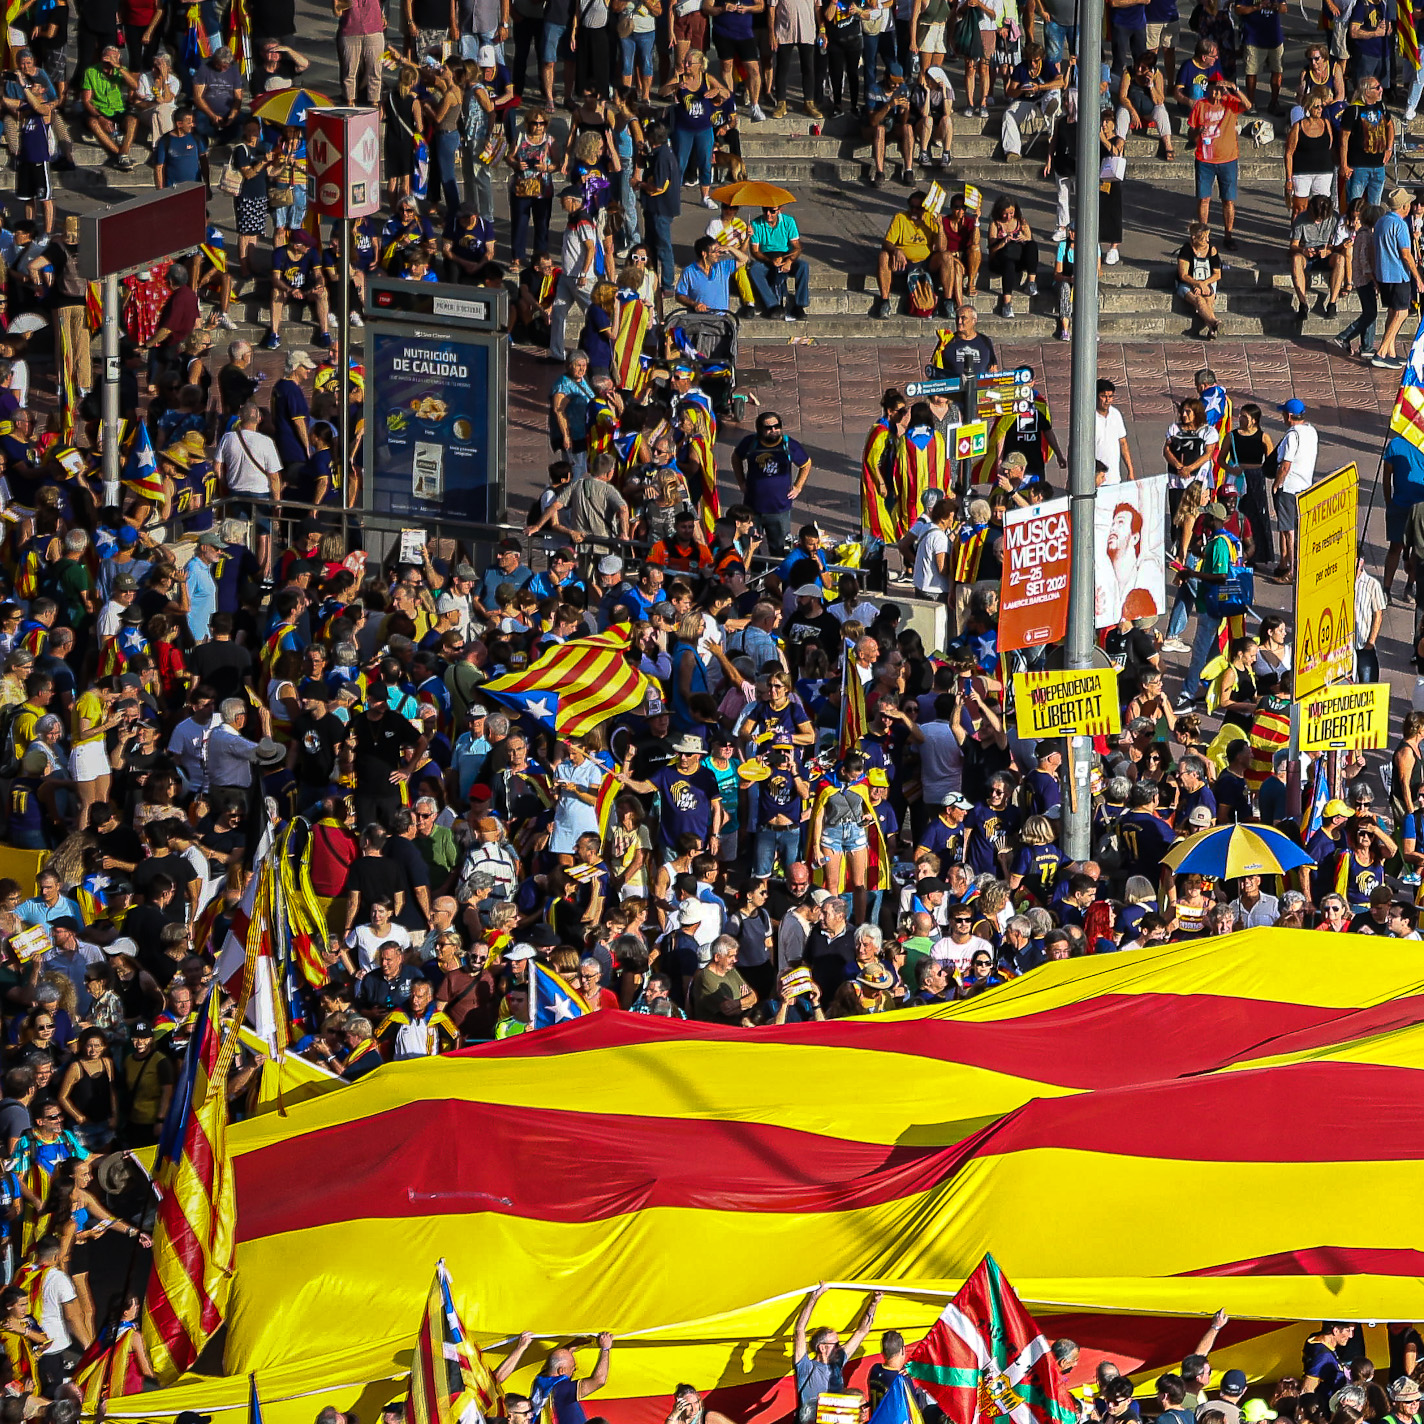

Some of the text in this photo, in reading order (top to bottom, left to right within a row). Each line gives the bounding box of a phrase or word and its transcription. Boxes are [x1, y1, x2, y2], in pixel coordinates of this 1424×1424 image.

[393, 357, 468, 379] DE CALIDAD
[403, 347, 457, 363] NUTRICIÓN
[1311, 489, 1346, 526] ATENCIÓ
[1006, 515, 1070, 550] MÚSICA
[1312, 539, 1321, 555] Pas
[1011, 534, 1068, 571] MERCÈ
[1315, 561, 1338, 586] per obres
[1026, 581, 1044, 597] SET
[1321, 625, 1330, 640] 30
[1030, 675, 1101, 705] INDEPENDÈNCIA
[1306, 690, 1374, 720] INDEPENDÈNCIA
[1032, 695, 1102, 732] LLIBERTAT
[1305, 710, 1374, 745] LLIBERTAT
